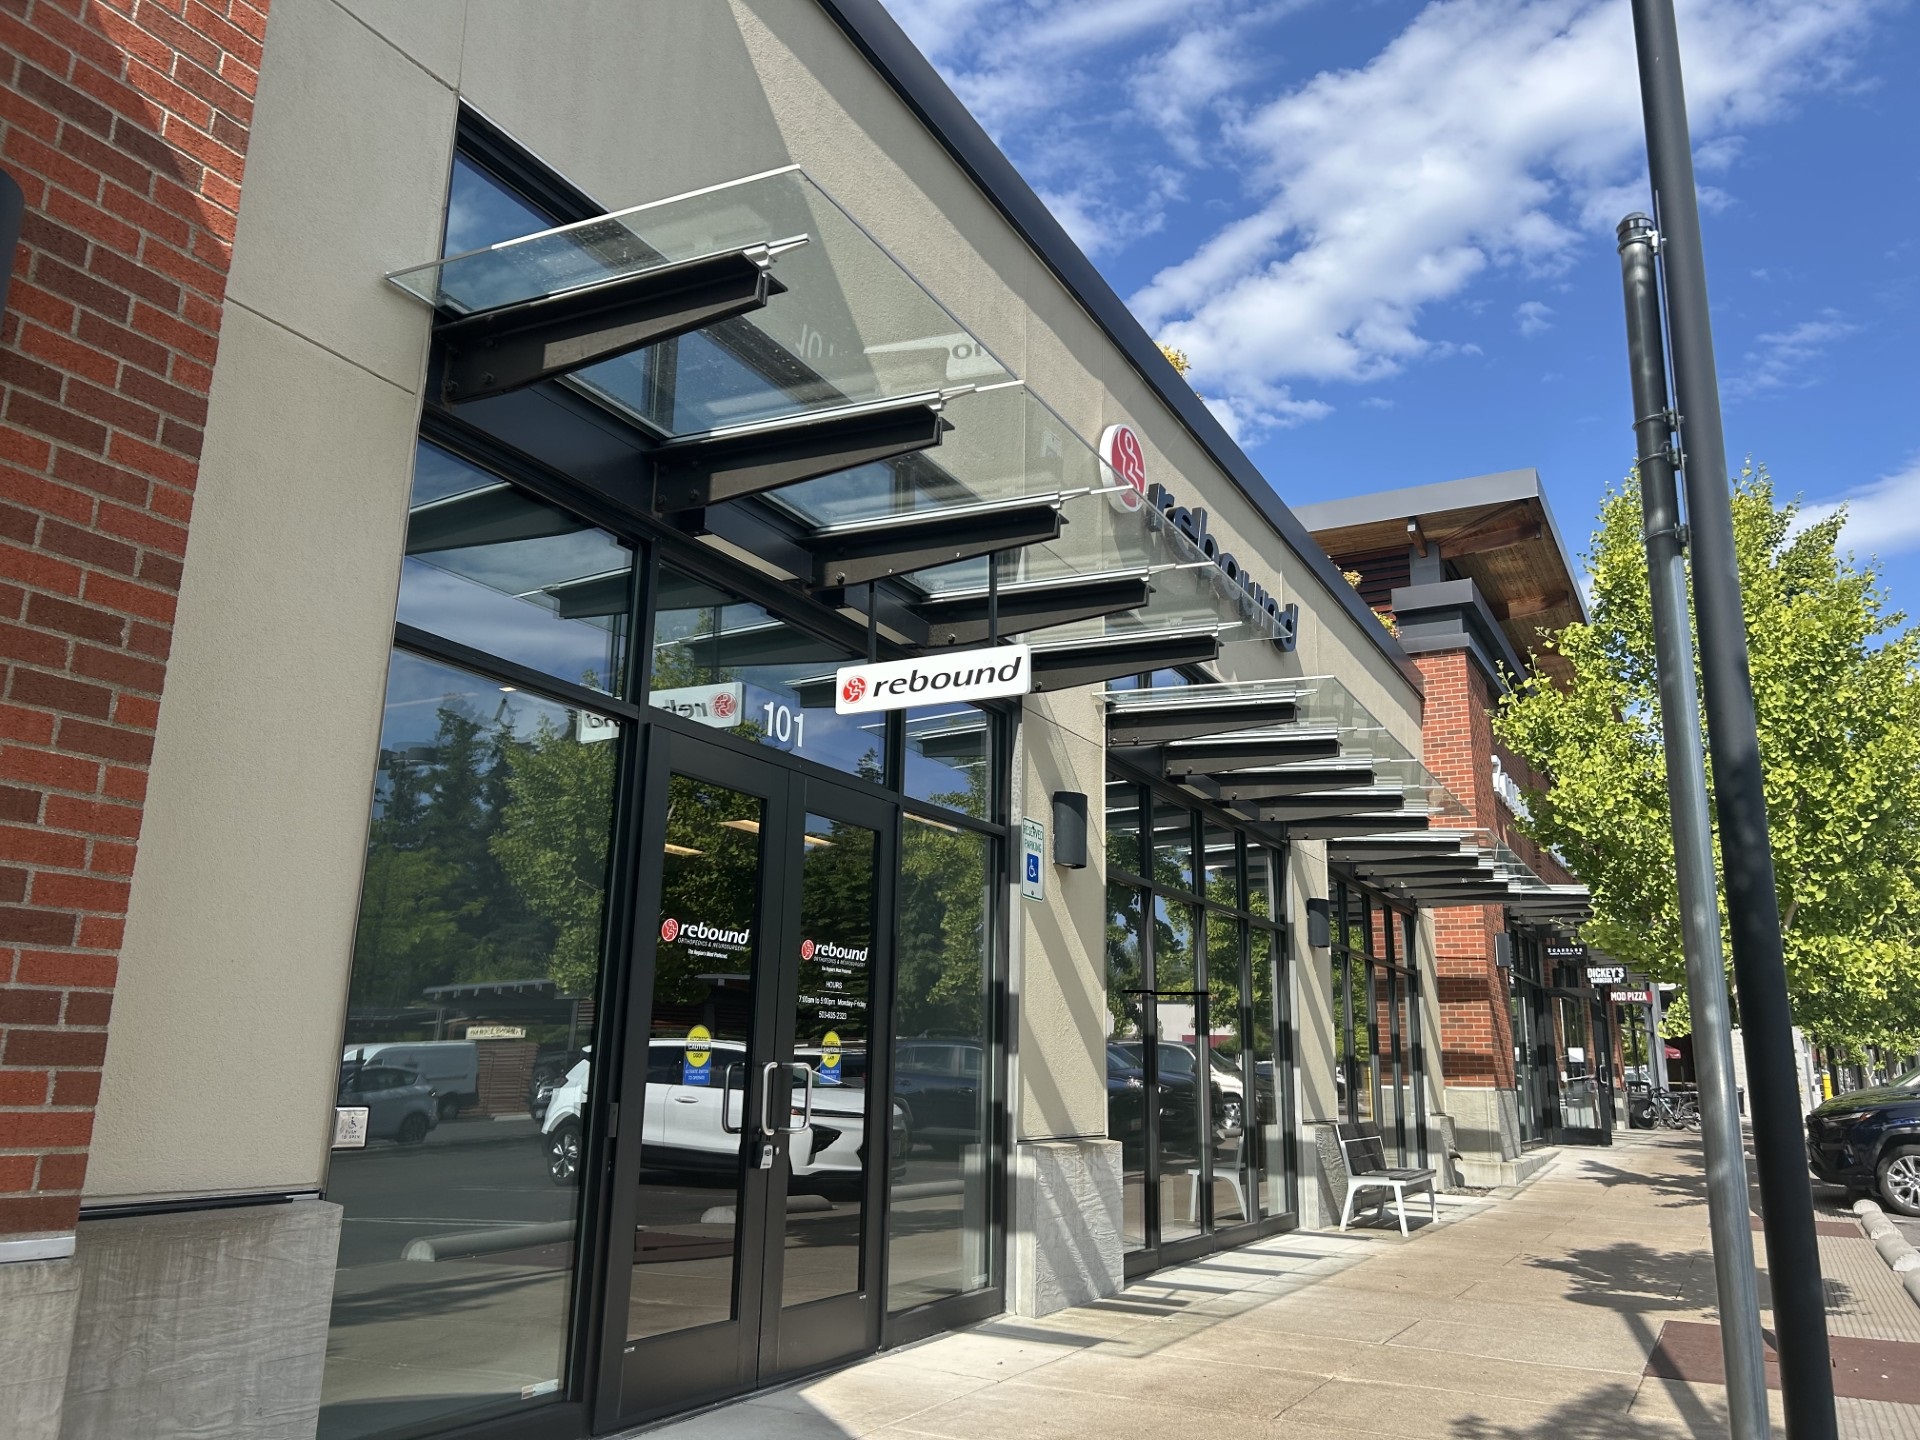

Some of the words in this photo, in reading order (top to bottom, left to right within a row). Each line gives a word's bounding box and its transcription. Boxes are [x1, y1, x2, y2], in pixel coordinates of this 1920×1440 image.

[1148, 482, 1299, 653] rebound
[872, 656, 1023, 698] rebound
[763, 700, 805, 749] 101
[679, 922, 749, 944] rebound
[677, 937, 708, 947] ORTHOPEDICS
[712, 943, 746, 952] NEUROSURGERY
[815, 942, 868, 961] rebound
[1586, 967, 1625, 978] DICKEY'S
[825, 981, 843, 989] HOURS
[798, 994, 815, 1004] 7:00am
[837, 998, 867, 1010] Monday-Friday
[1610, 991, 1627, 1001] MOD
[1627, 991, 1648, 1001] PIZZA
